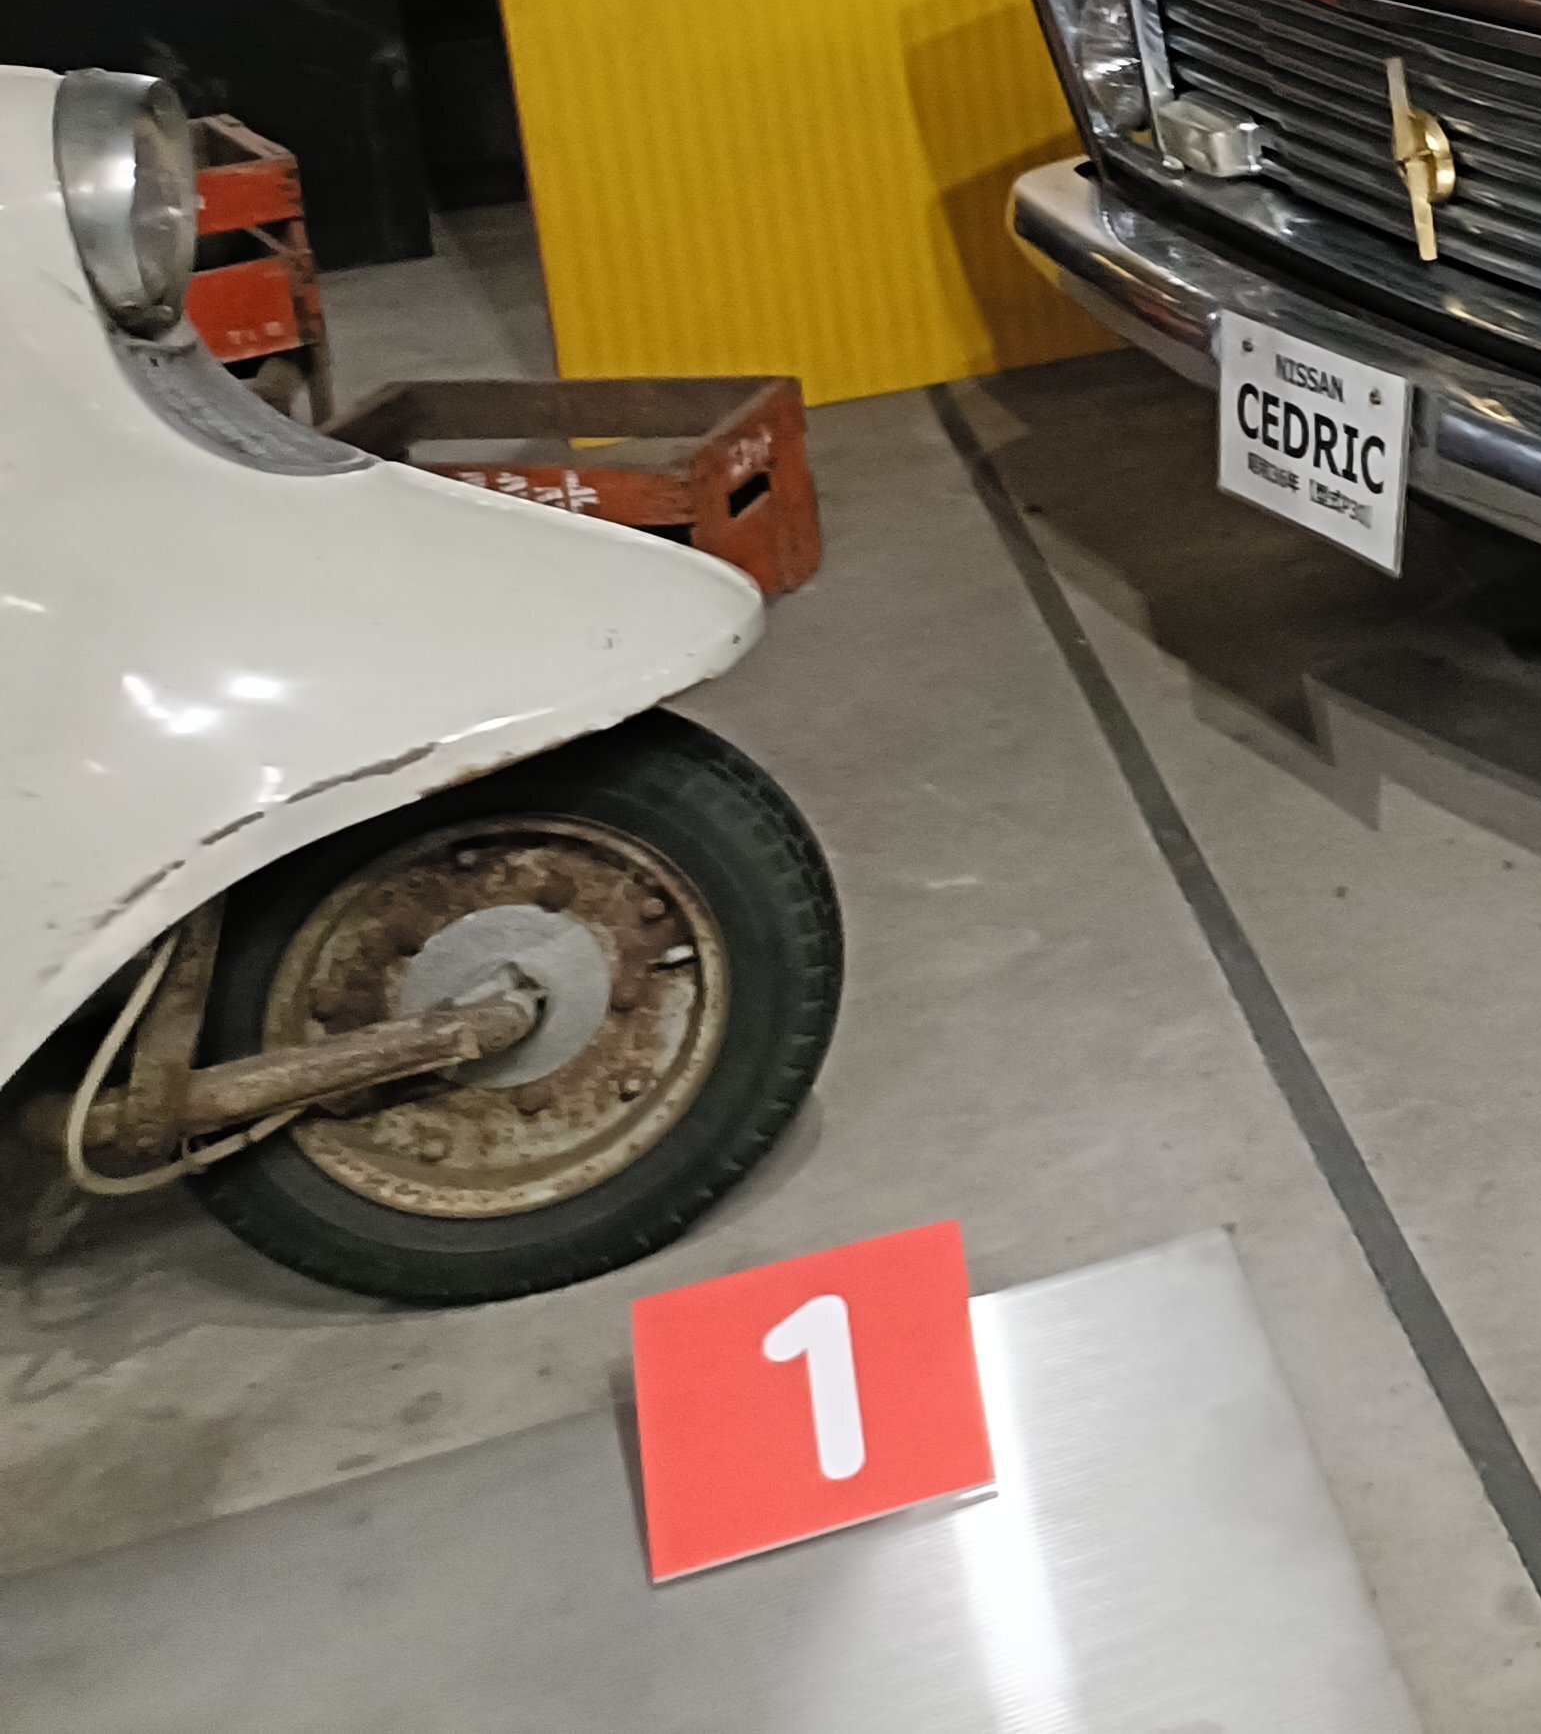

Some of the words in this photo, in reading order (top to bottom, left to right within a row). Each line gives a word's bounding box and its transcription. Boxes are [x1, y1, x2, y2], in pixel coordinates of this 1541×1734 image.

[1275, 353, 1345, 403] NISSAN
[1236, 382, 1386, 495] CEDRIC
[762, 1293, 866, 1481] 1
